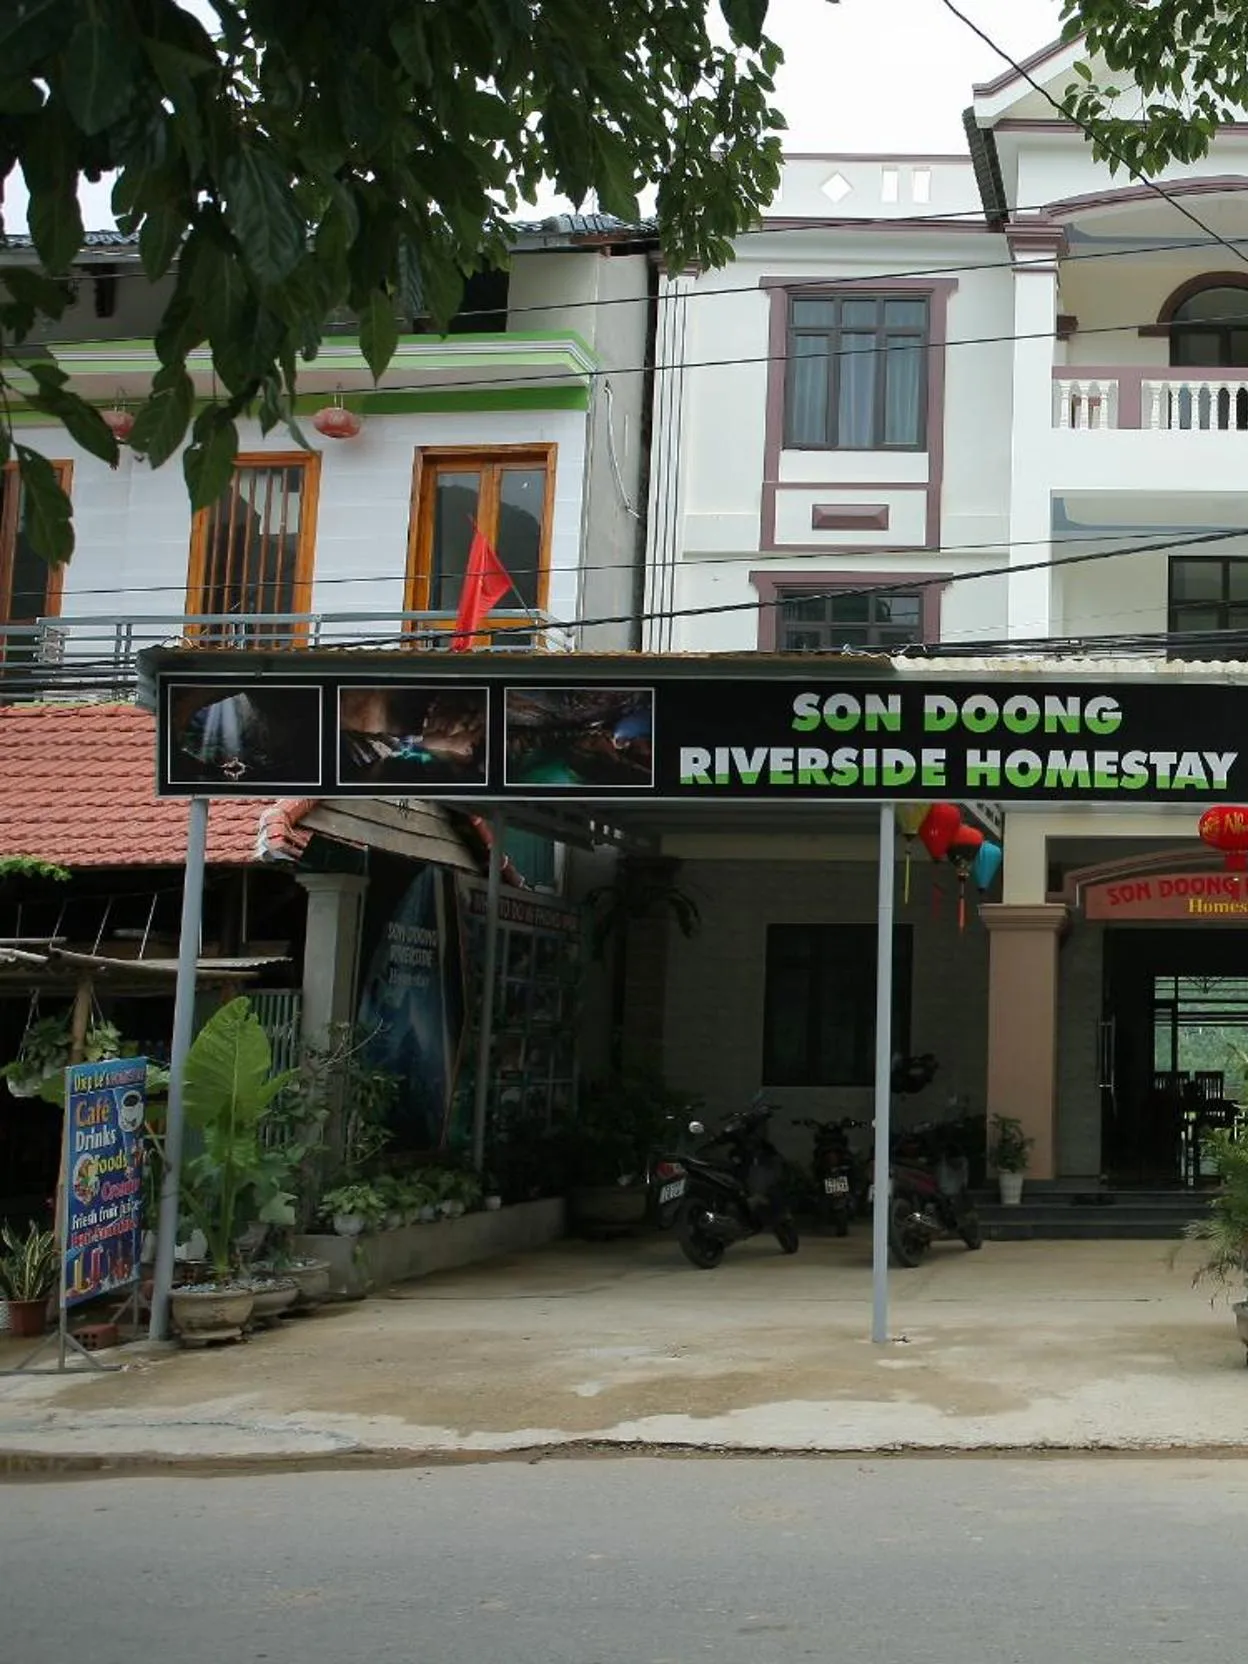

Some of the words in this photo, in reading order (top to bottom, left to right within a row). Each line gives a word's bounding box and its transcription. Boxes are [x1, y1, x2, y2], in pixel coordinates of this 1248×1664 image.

[792, 693, 901, 733] SON
[924, 694, 1123, 735] DOONG
[680, 746, 947, 787] RIVERSIDE
[966, 748, 1238, 790] HOMESTAY
[1107, 883, 1152, 906] SON
[76, 1123, 117, 1153] Drinks
